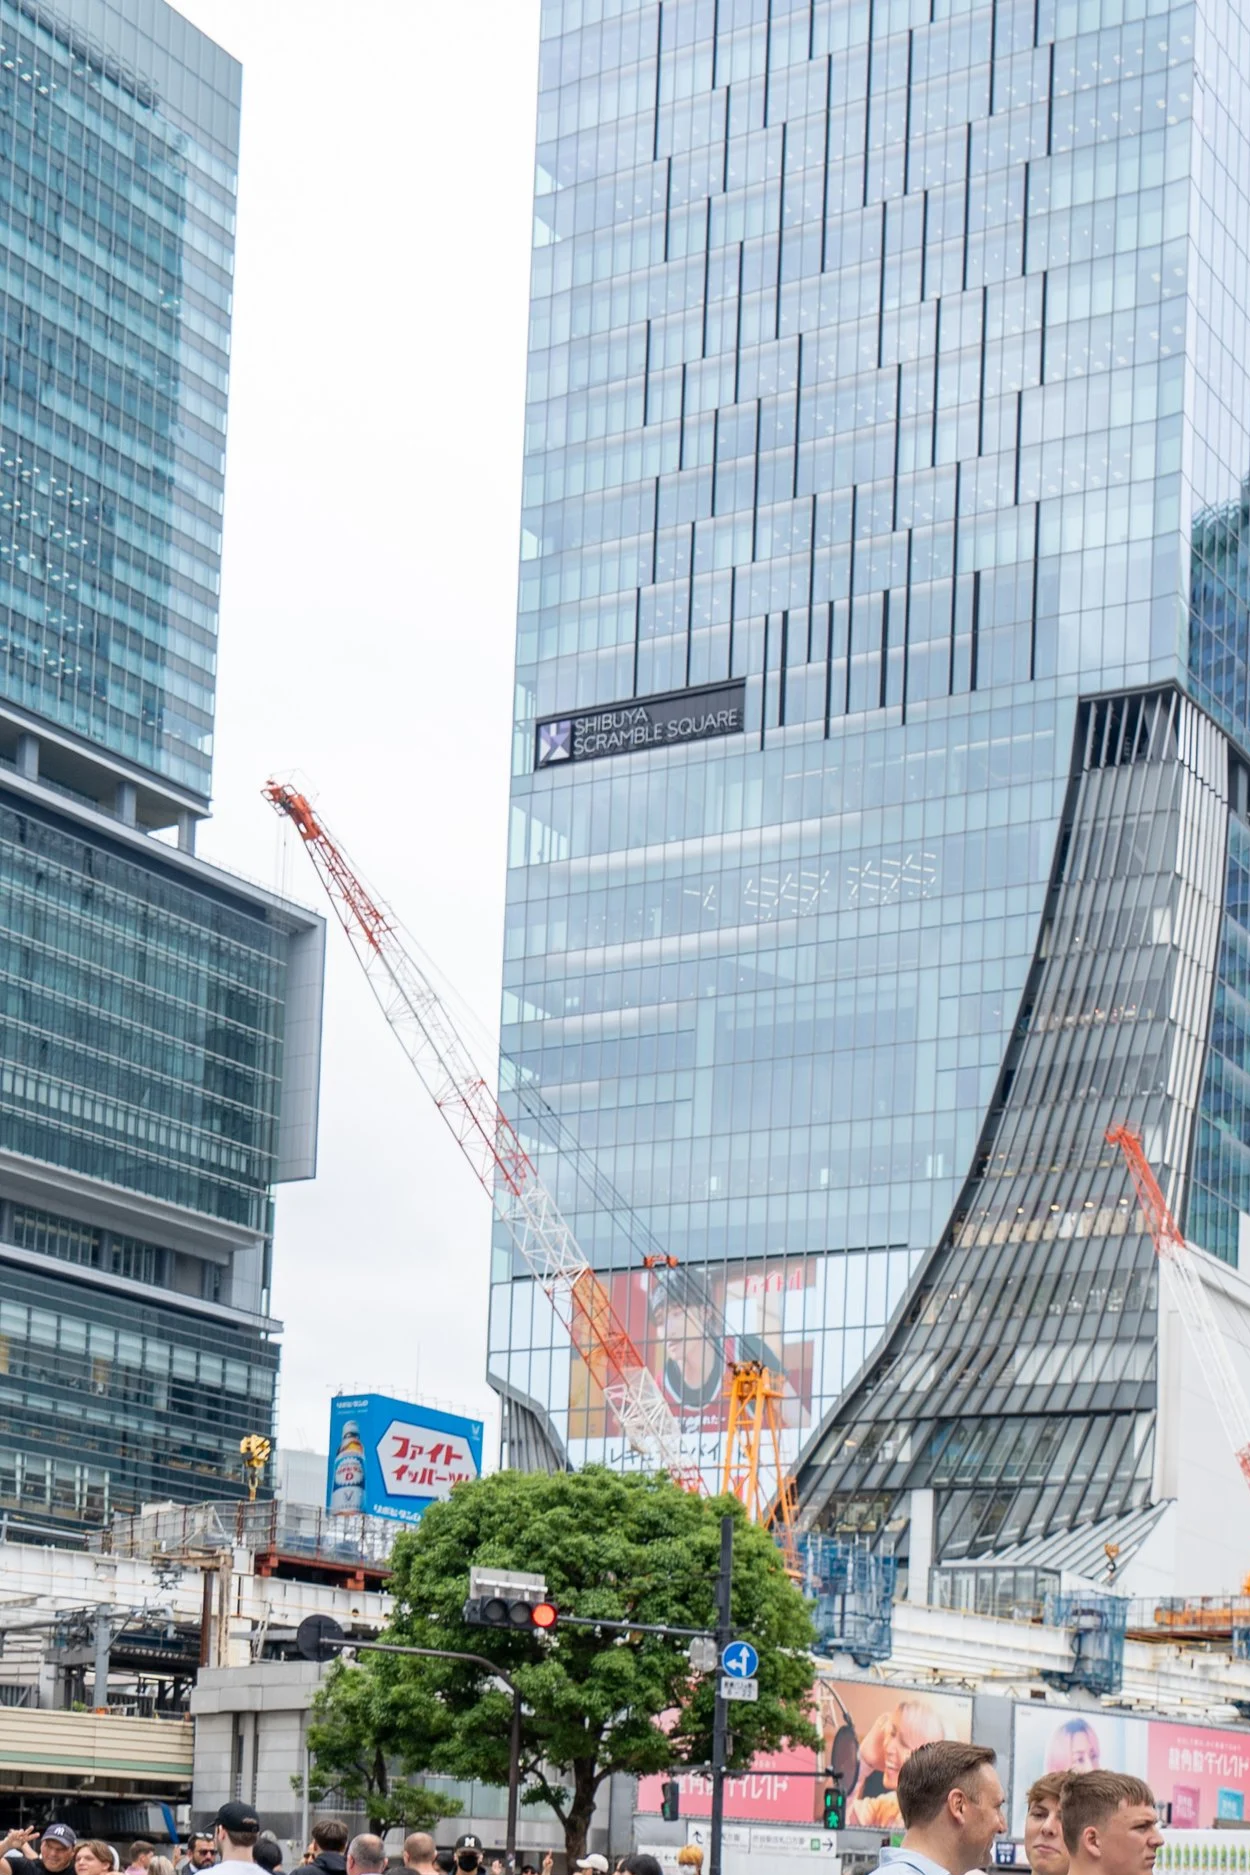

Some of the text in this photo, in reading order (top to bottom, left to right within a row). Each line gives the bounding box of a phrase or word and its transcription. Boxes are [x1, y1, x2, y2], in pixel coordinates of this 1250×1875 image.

[573, 708, 738, 755] SCRAMBLE SQUARE
[574, 706, 649, 736] SHIBUYA
[392, 1436, 463, 1466] ファイト
